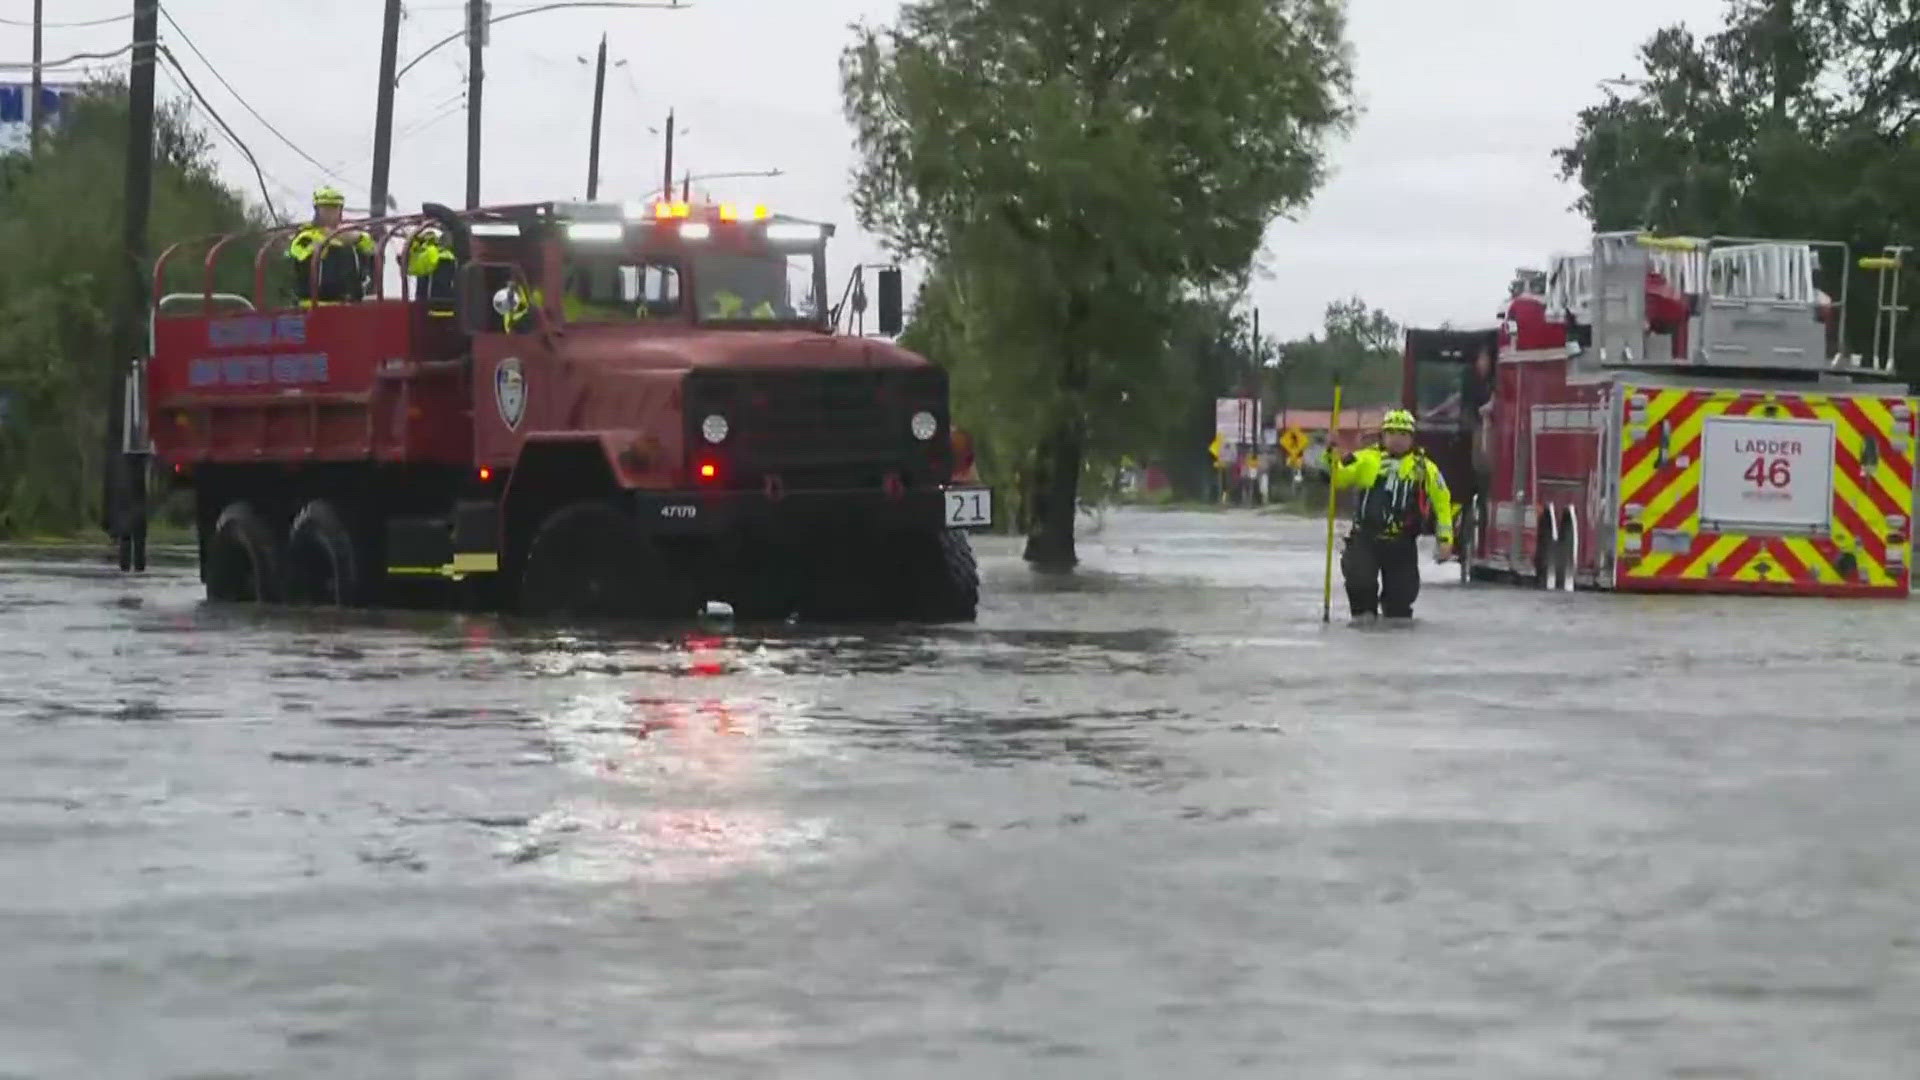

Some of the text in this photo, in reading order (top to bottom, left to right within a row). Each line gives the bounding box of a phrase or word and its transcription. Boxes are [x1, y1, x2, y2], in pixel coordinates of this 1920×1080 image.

[1735, 439, 1802, 455] LADDER
[1744, 457, 1791, 488] 46
[952, 494, 985, 521] 21
